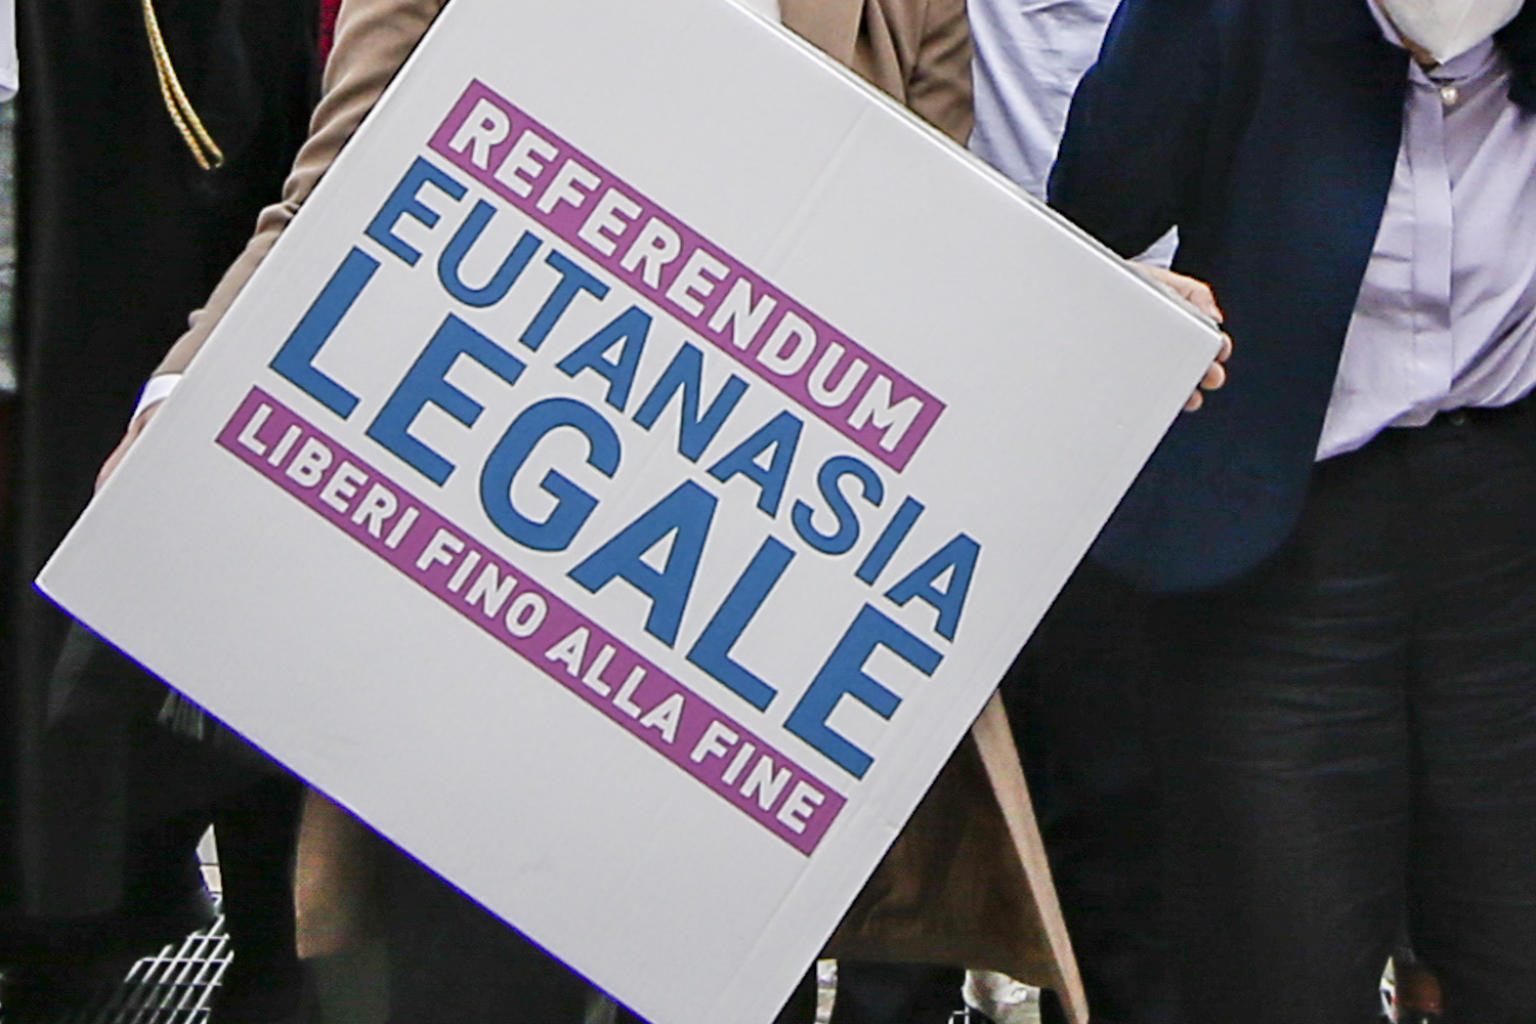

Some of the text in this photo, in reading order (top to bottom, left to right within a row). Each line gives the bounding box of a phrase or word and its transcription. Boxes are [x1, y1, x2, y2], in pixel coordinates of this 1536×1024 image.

[363, 156, 983, 643] EUTANASIA
[448, 98, 925, 455] REFERENDUM
[236, 403, 825, 834] LIBERI FINO ALLA FINE
[268, 244, 945, 782] LEGALE
